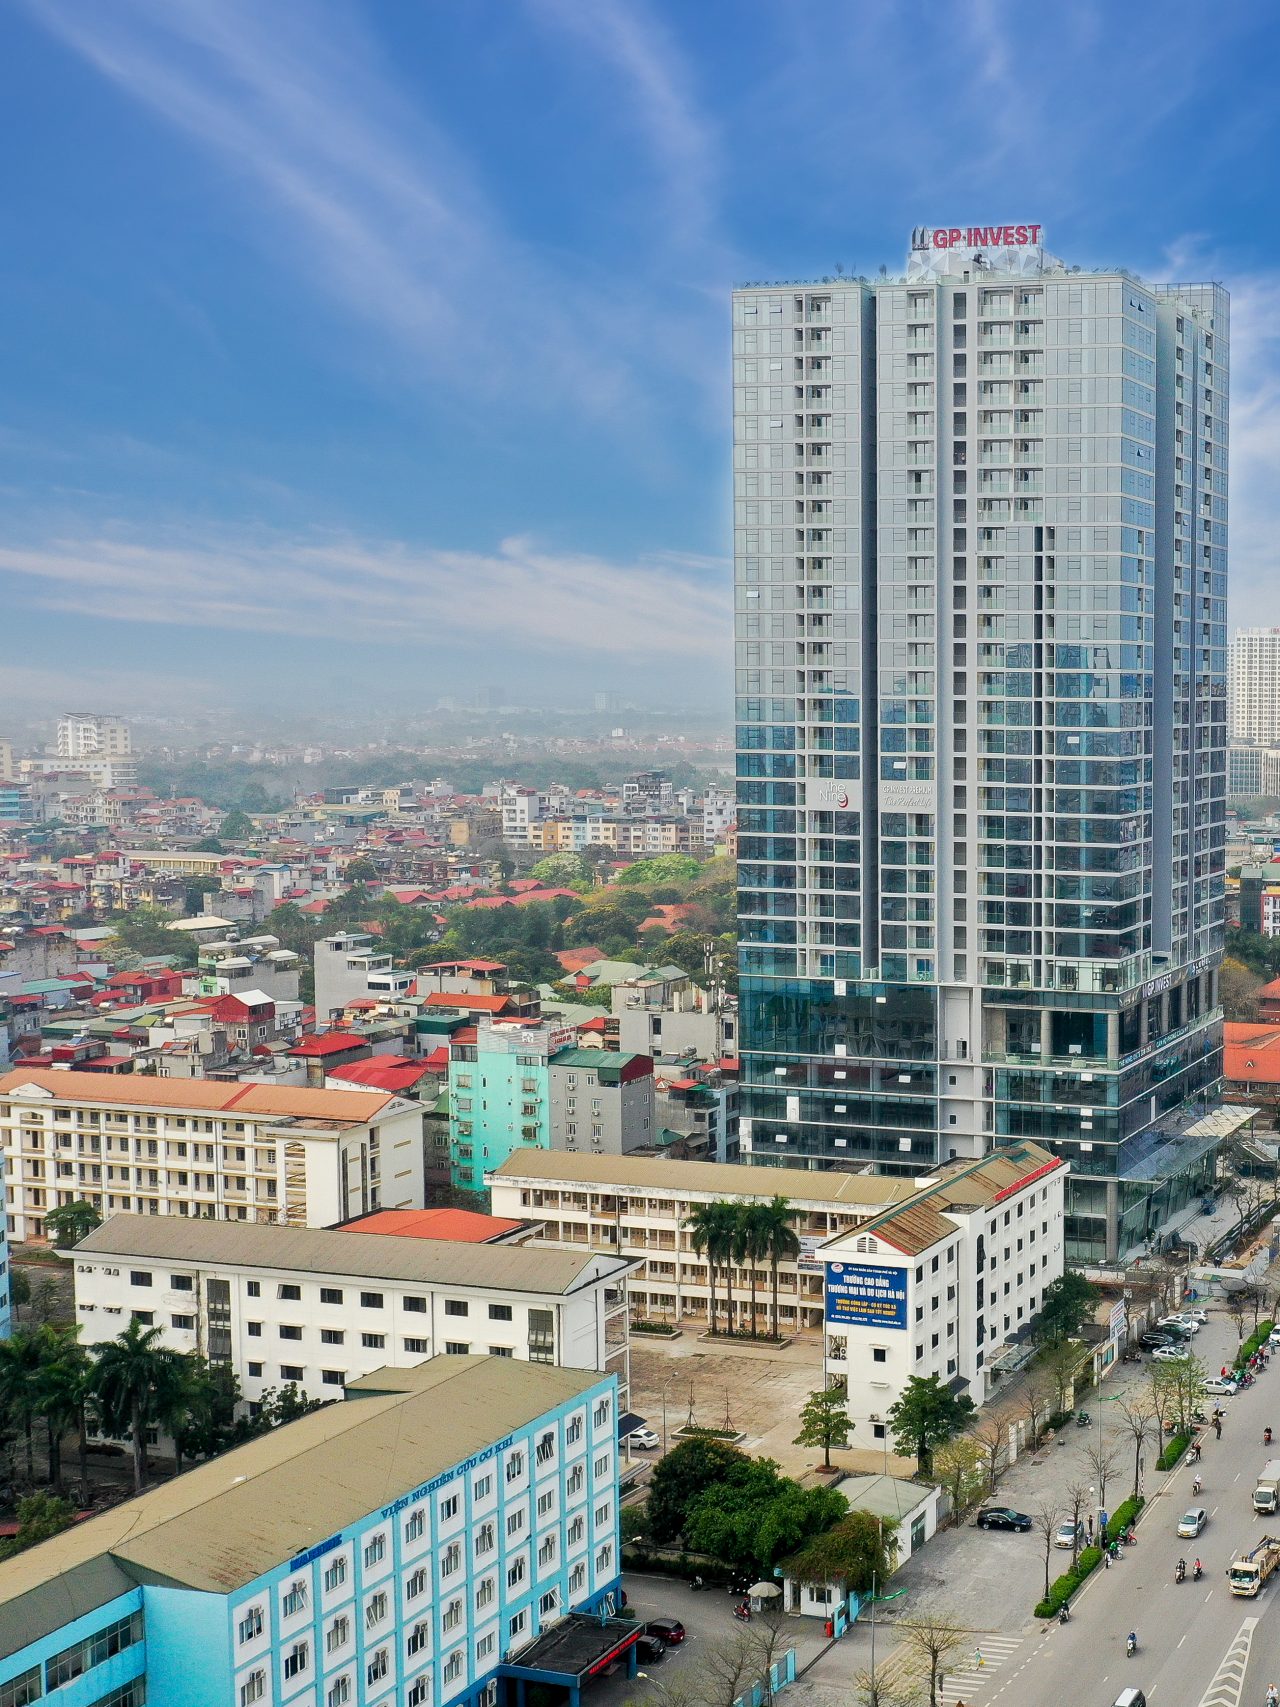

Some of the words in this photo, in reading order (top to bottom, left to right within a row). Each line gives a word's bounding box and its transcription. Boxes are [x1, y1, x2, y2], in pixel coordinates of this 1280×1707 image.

[825, 781, 846, 792] The
[864, 1277, 875, 1286] CAO
[887, 1289, 895, 1299] HÀ
[895, 1290, 905, 1301] NỘI
[381, 1499, 409, 1519] VIỆN
[411, 1471, 455, 1502] NGHIÊN
[479, 1448, 493, 1463] CƠ
[494, 1435, 514, 1455] KHÍ
